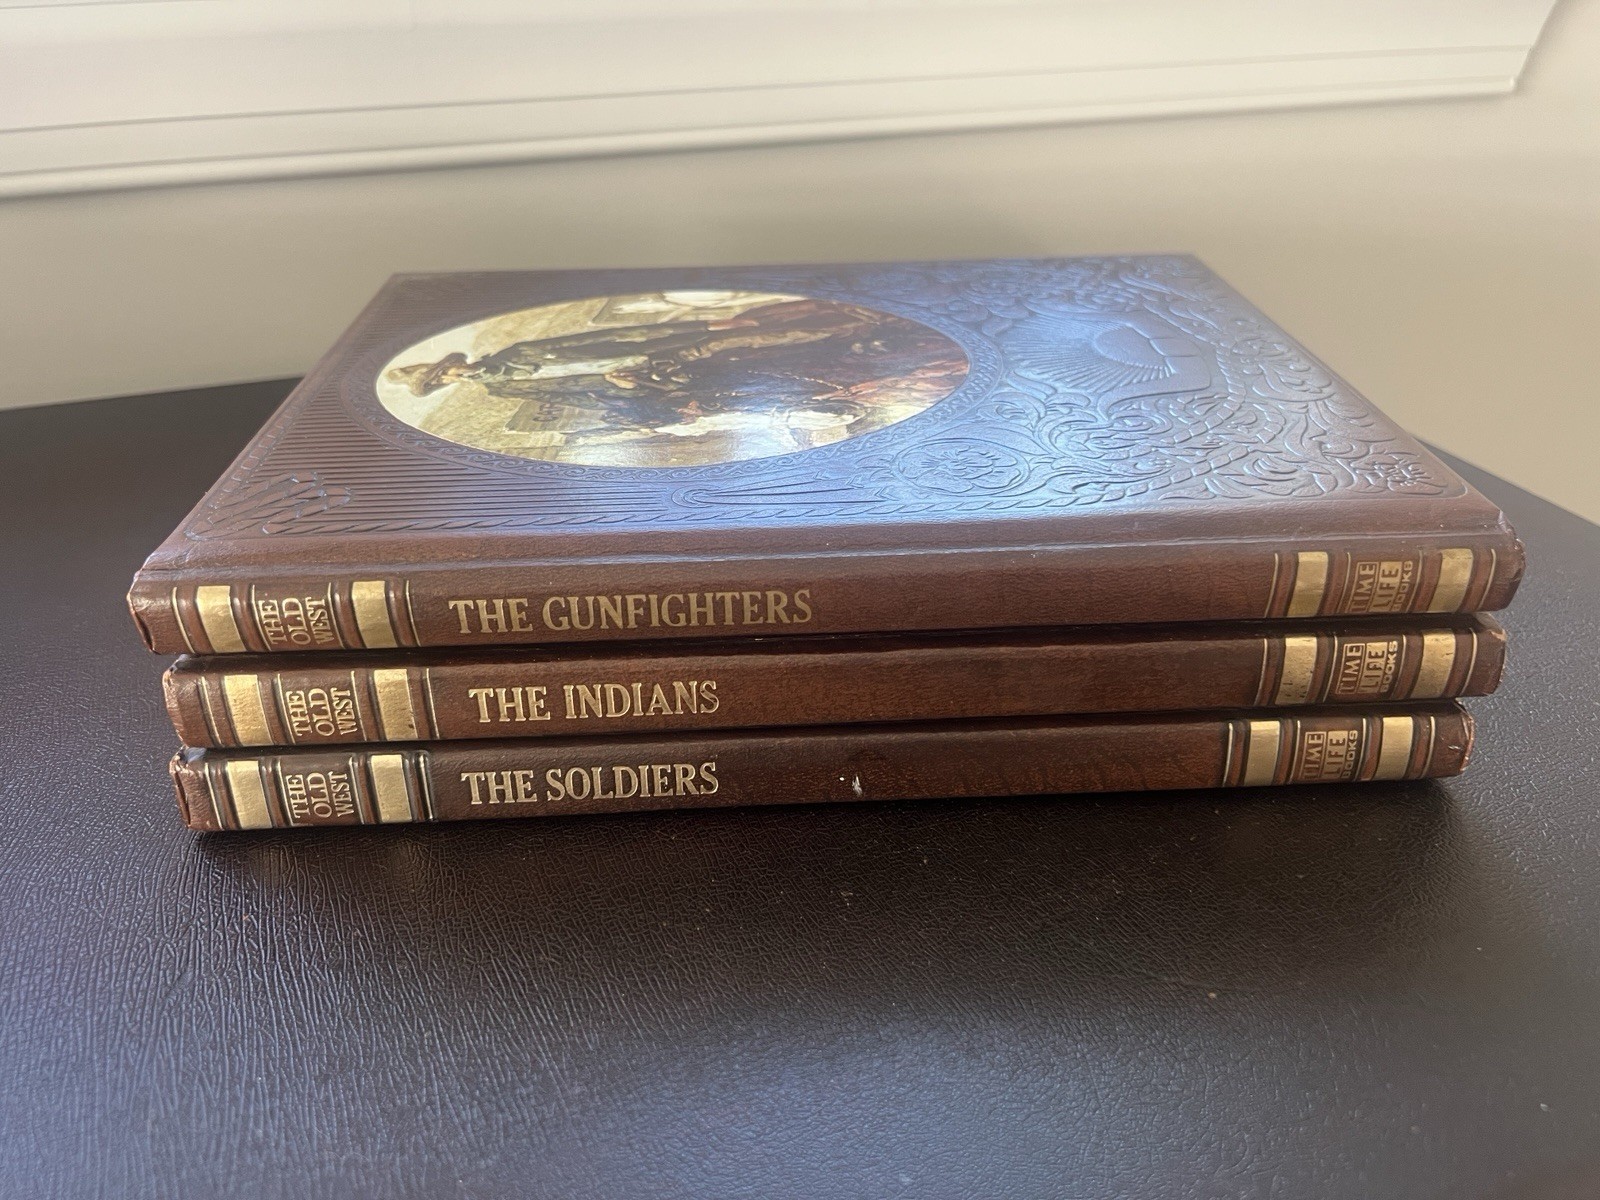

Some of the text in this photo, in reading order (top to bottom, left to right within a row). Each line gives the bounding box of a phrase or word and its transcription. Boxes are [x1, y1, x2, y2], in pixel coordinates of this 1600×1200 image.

[1351, 562, 1377, 613] TIME
[1372, 566, 1400, 610] LIFE
[258, 599, 283, 645] THE
[282, 597, 309, 645] OLD
[306, 596, 335, 645] WEST
[449, 589, 812, 634] THE GUNFIGHTERS
[1339, 643, 1363, 694] TIME
[1360, 648, 1385, 690] LIFE
[1380, 640, 1398, 693] BOOKS
[286, 690, 311, 737] THE
[307, 688, 335, 737] OLD
[331, 687, 358, 735] WEST
[468, 680, 720, 723] THE INDIANS
[1303, 732, 1324, 780] TIME
[1323, 736, 1346, 776] LIFE
[1340, 729, 1358, 778] BOOKS
[285, 774, 311, 818] THE
[307, 772, 331, 818] OLD
[328, 771, 354, 818] WEST
[460, 762, 719, 804] THE SOLDIERS
